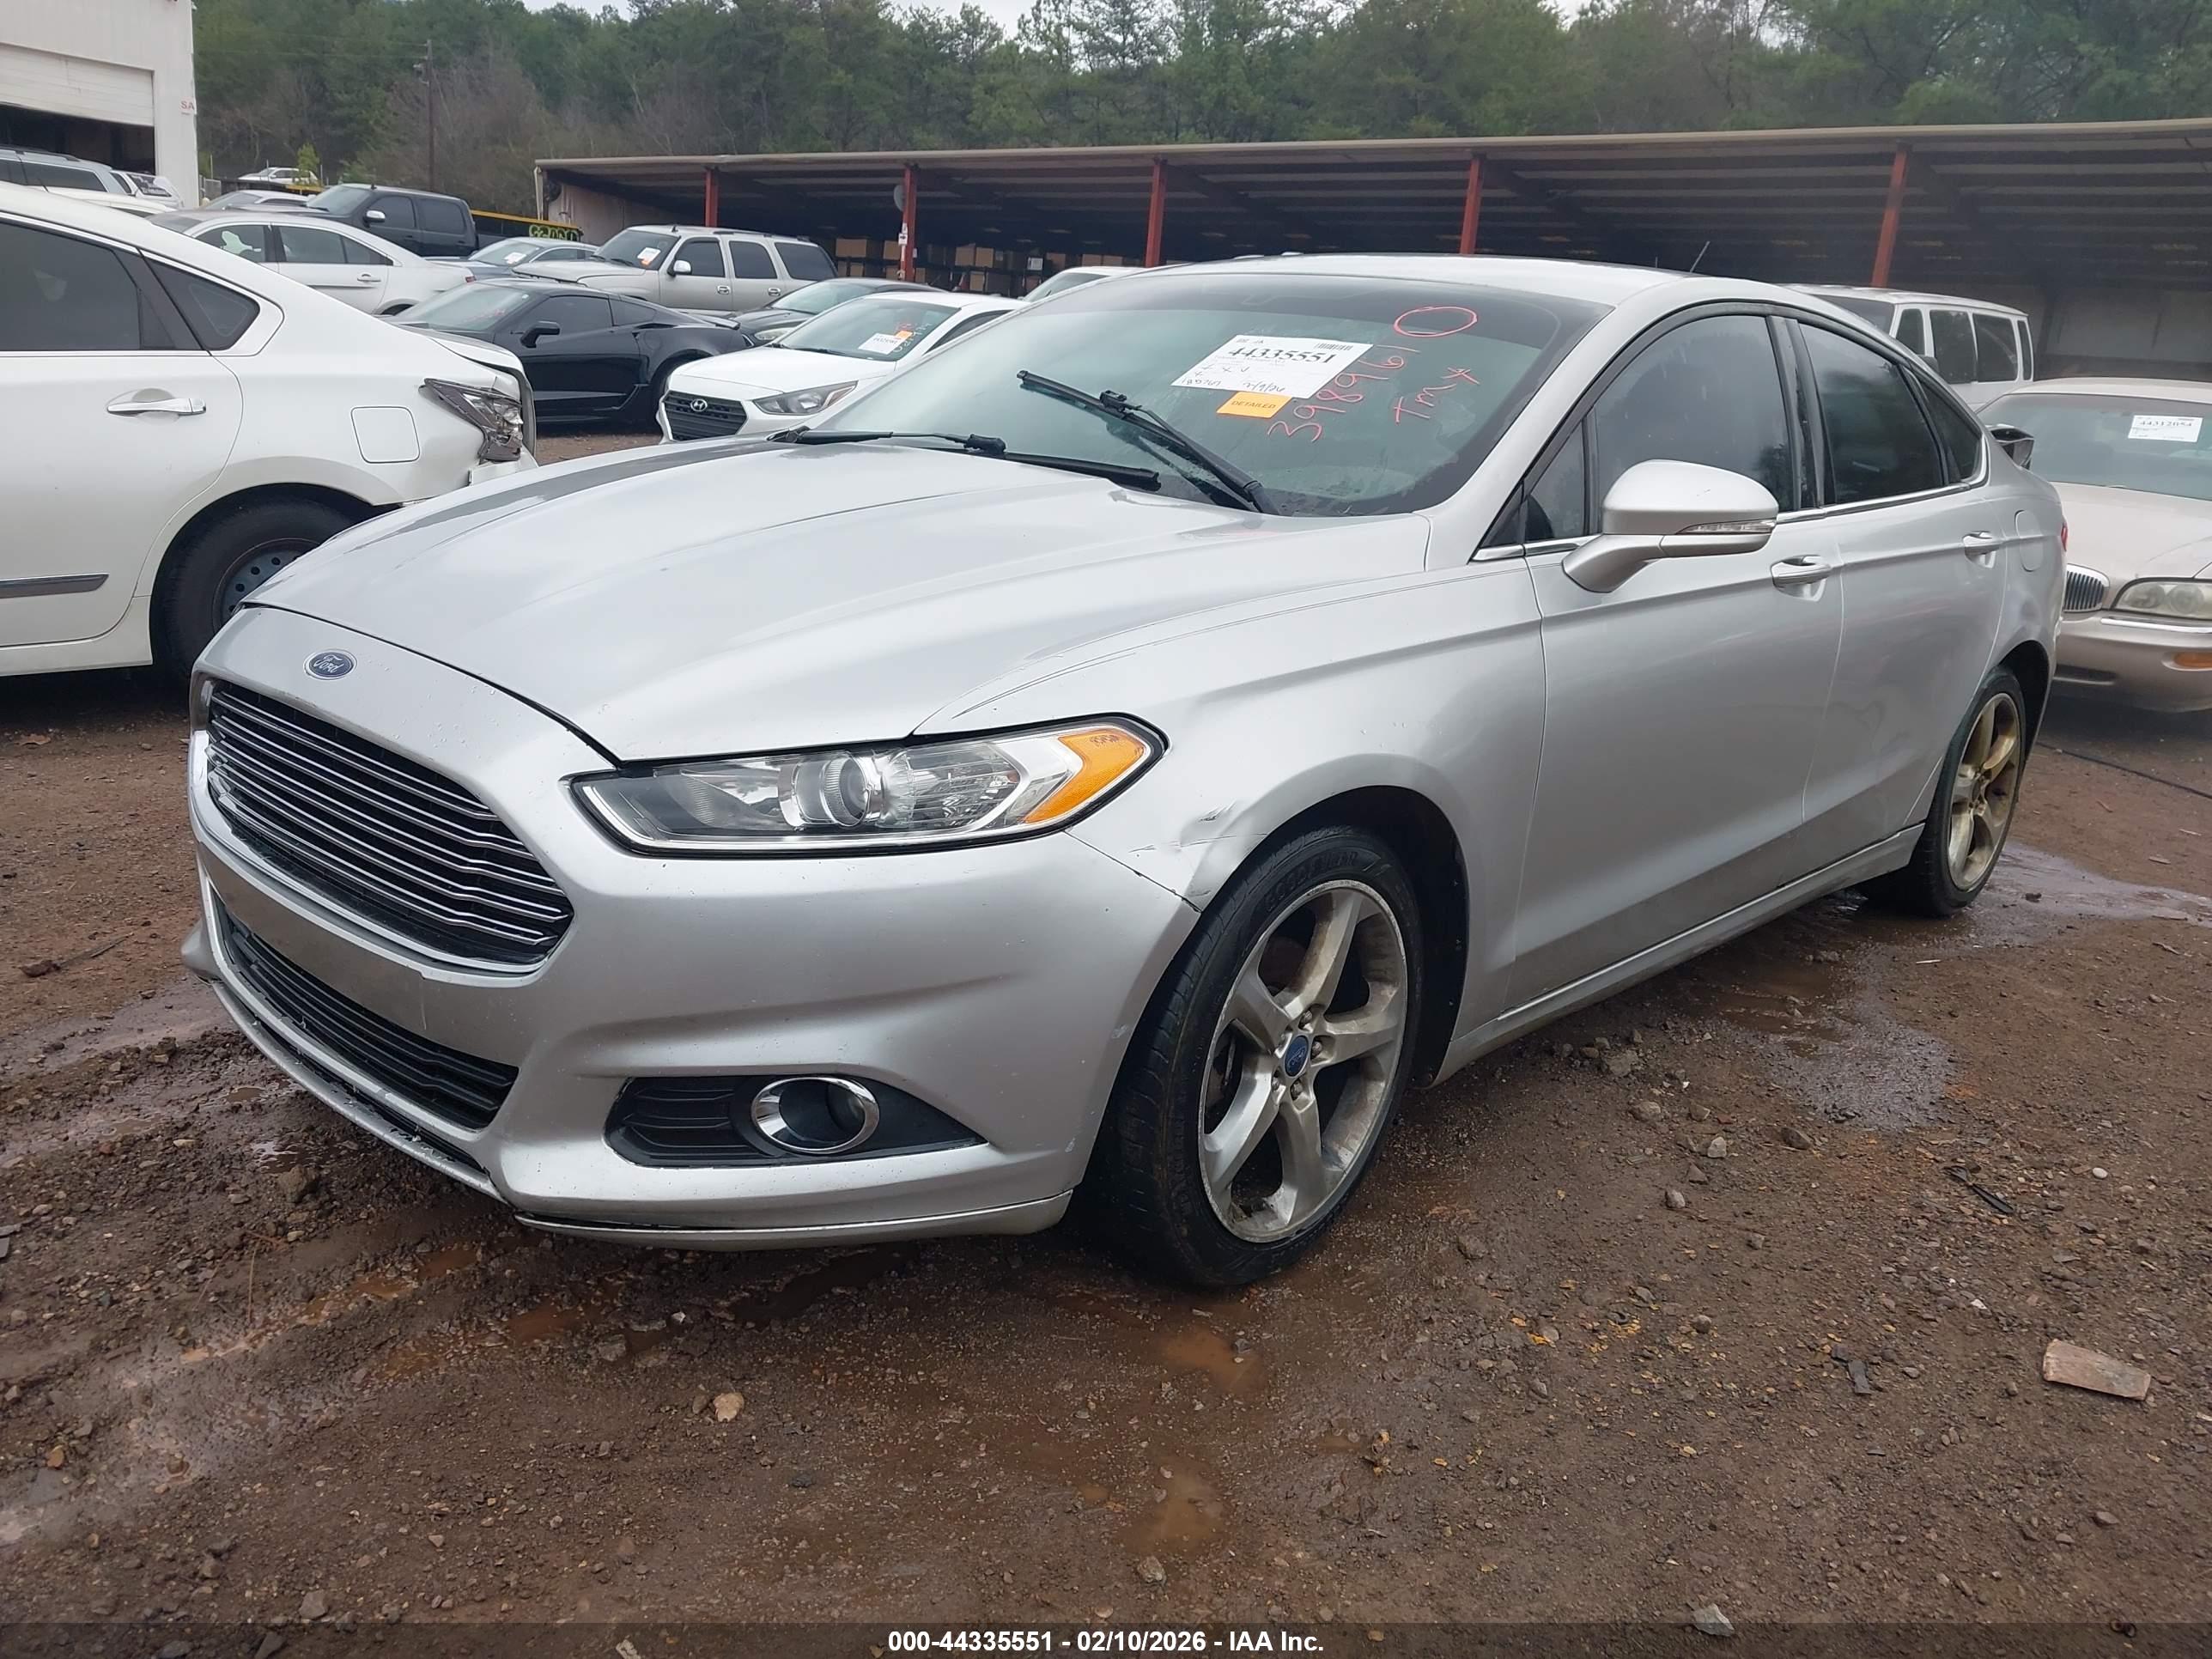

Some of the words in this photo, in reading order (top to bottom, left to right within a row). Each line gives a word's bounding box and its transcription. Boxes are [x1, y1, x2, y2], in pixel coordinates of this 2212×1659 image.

[1228, 346, 1338, 363] 44335551
[1231, 400, 1277, 409] DETAILED
[313, 654, 345, 673] Ford
